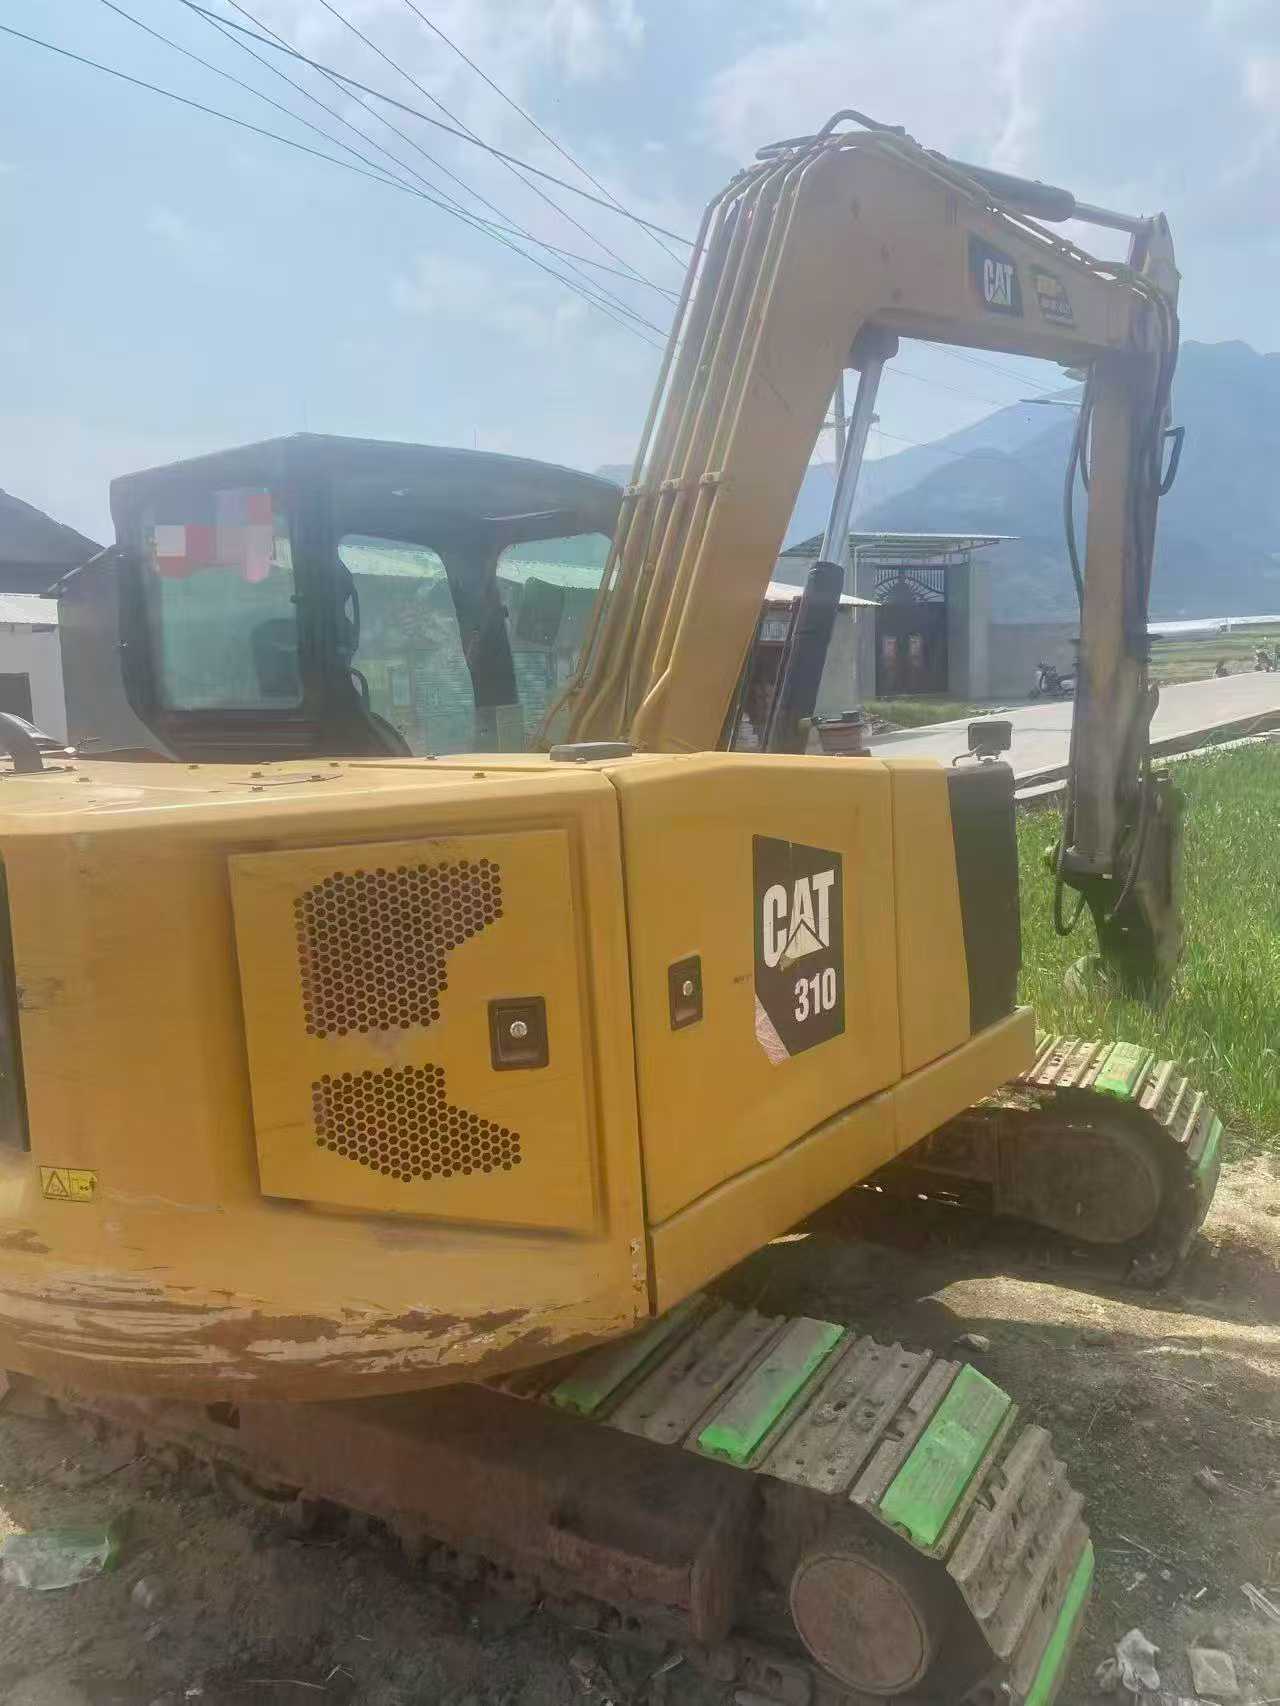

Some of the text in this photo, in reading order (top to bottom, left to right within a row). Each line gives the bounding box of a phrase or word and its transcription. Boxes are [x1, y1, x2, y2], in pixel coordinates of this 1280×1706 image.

[983, 258, 1013, 305] CAT
[763, 869, 835, 968] CAT
[794, 967, 837, 1022] 310
